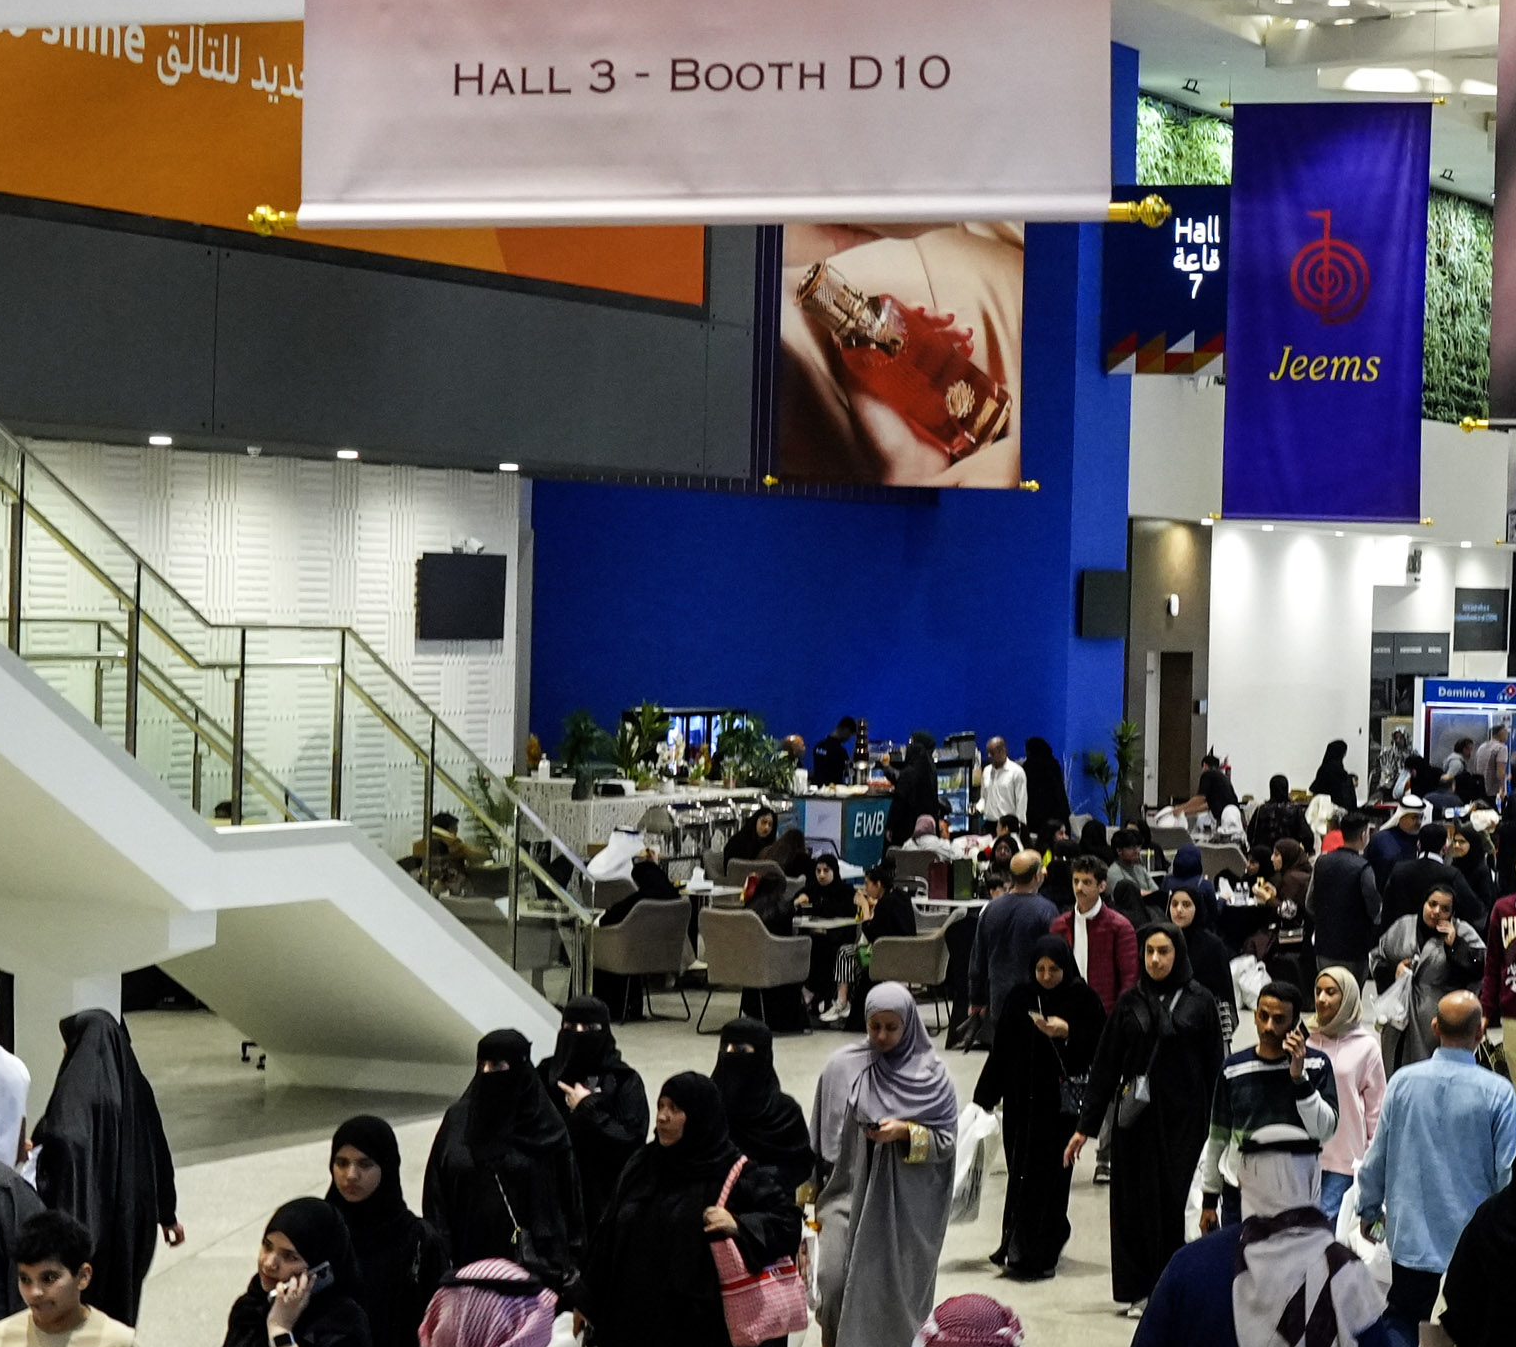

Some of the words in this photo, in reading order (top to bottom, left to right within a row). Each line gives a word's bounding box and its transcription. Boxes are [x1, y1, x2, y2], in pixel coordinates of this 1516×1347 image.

[588, 59, 616, 94] 3
[849, 54, 952, 91] D10
[1174, 214, 1221, 244] Hall
[1172, 244, 1221, 272] قاعة
[1188, 272, 1204, 300] 7
[1269, 346, 1381, 382] Jeems
[1438, 686, 1485, 698] Domino's
